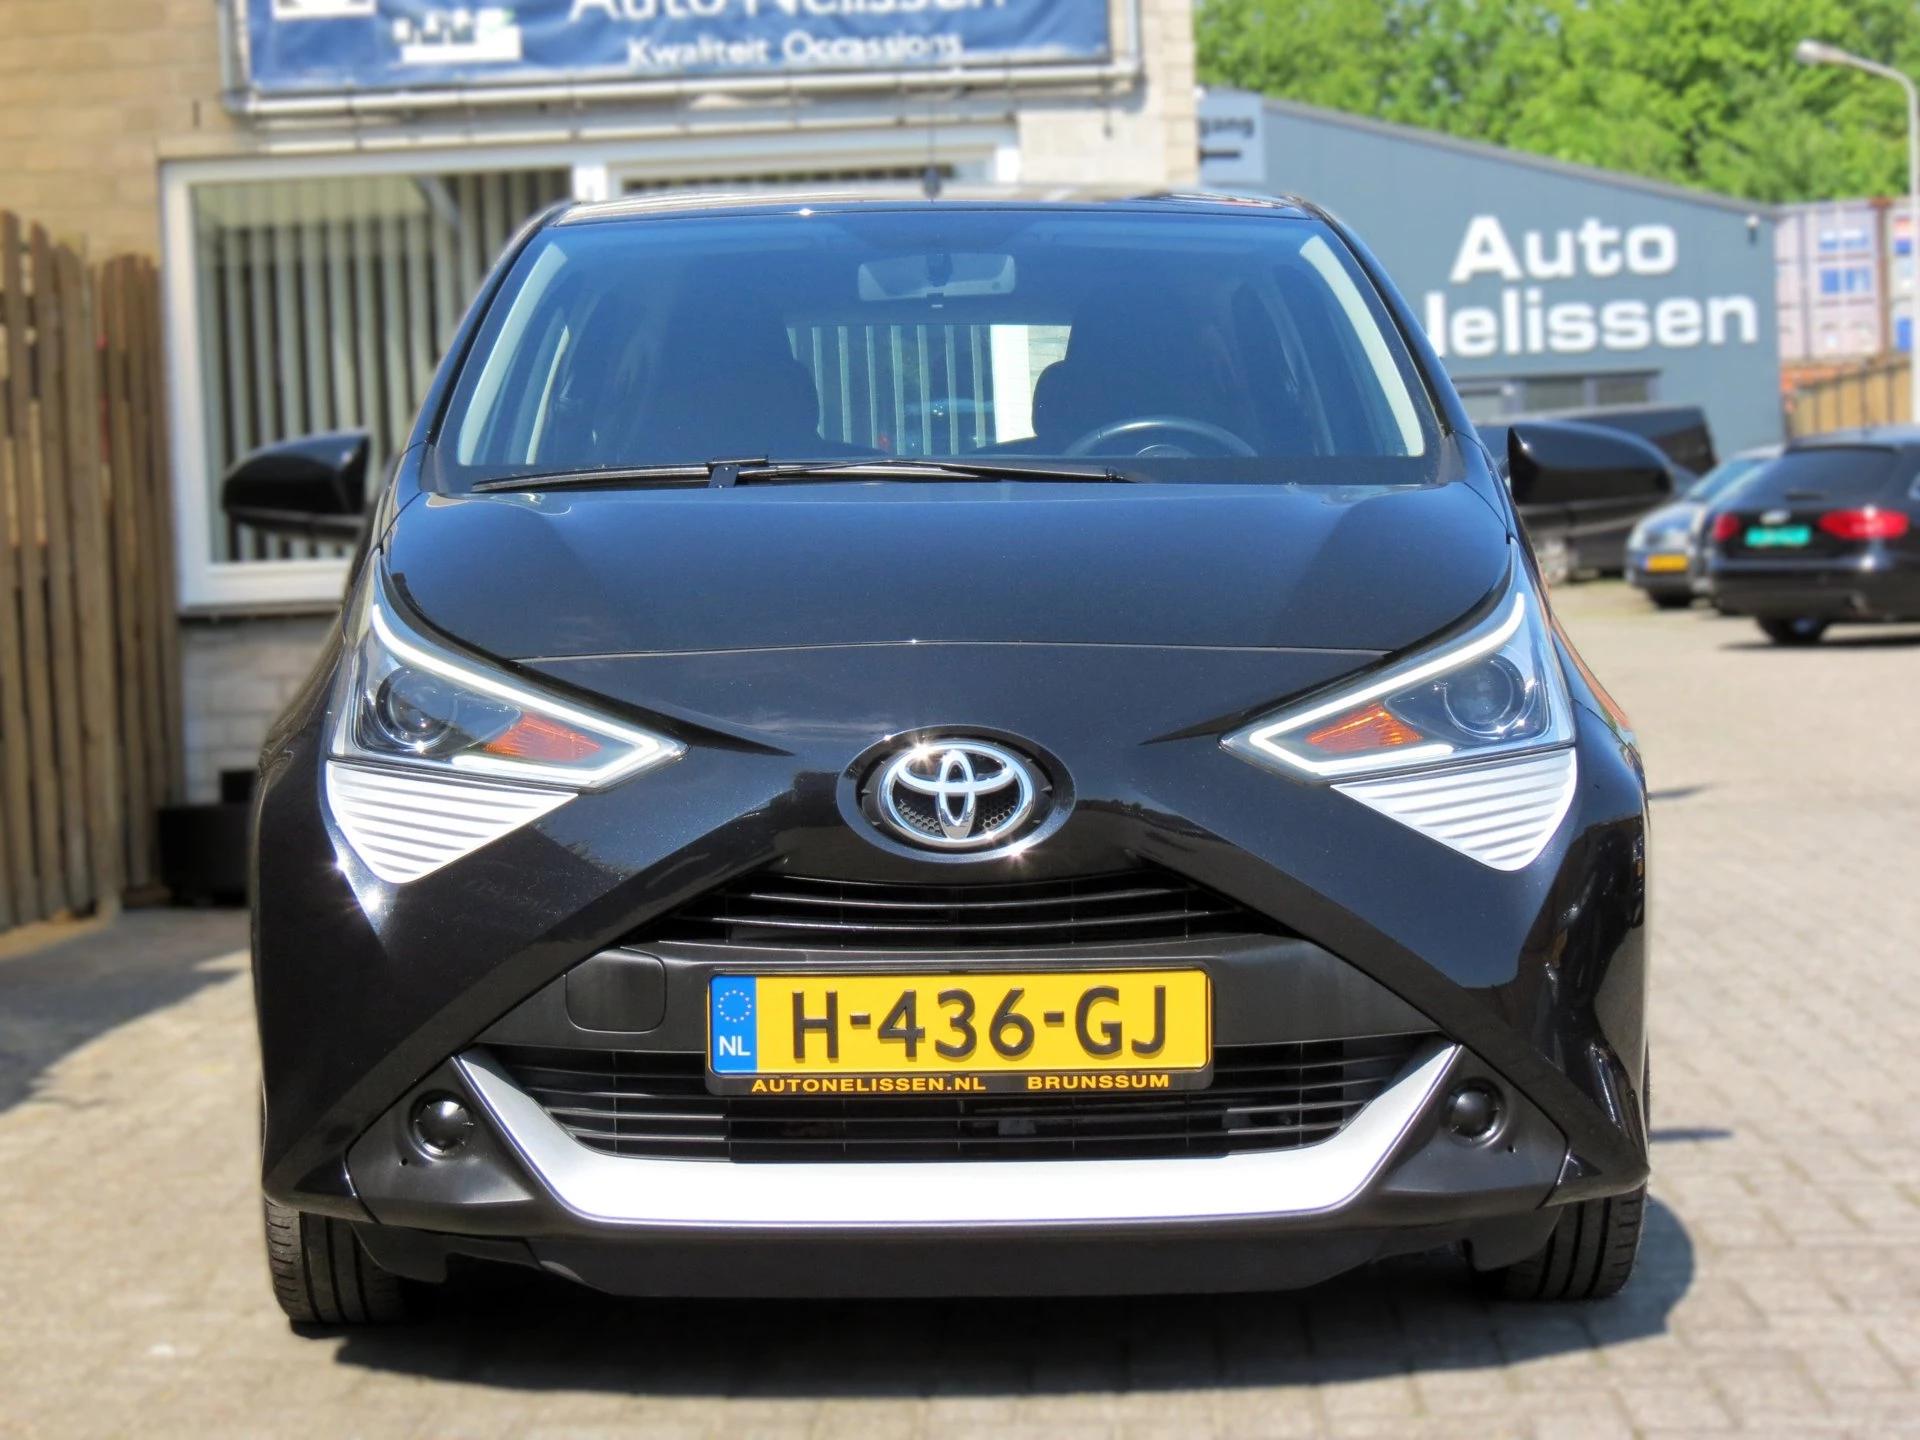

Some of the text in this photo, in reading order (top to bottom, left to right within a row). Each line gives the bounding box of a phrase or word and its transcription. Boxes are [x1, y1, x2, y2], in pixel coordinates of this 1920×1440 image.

[624, 31, 963, 67] Kwaliteit Occassions
[1449, 215, 1678, 283] Auto
[791, 984, 1168, 1062] H-436-GJ
[718, 1035, 751, 1056] NL
[750, 1073, 1171, 1093] AUTONELISSEN.NL BRUNSSUM
